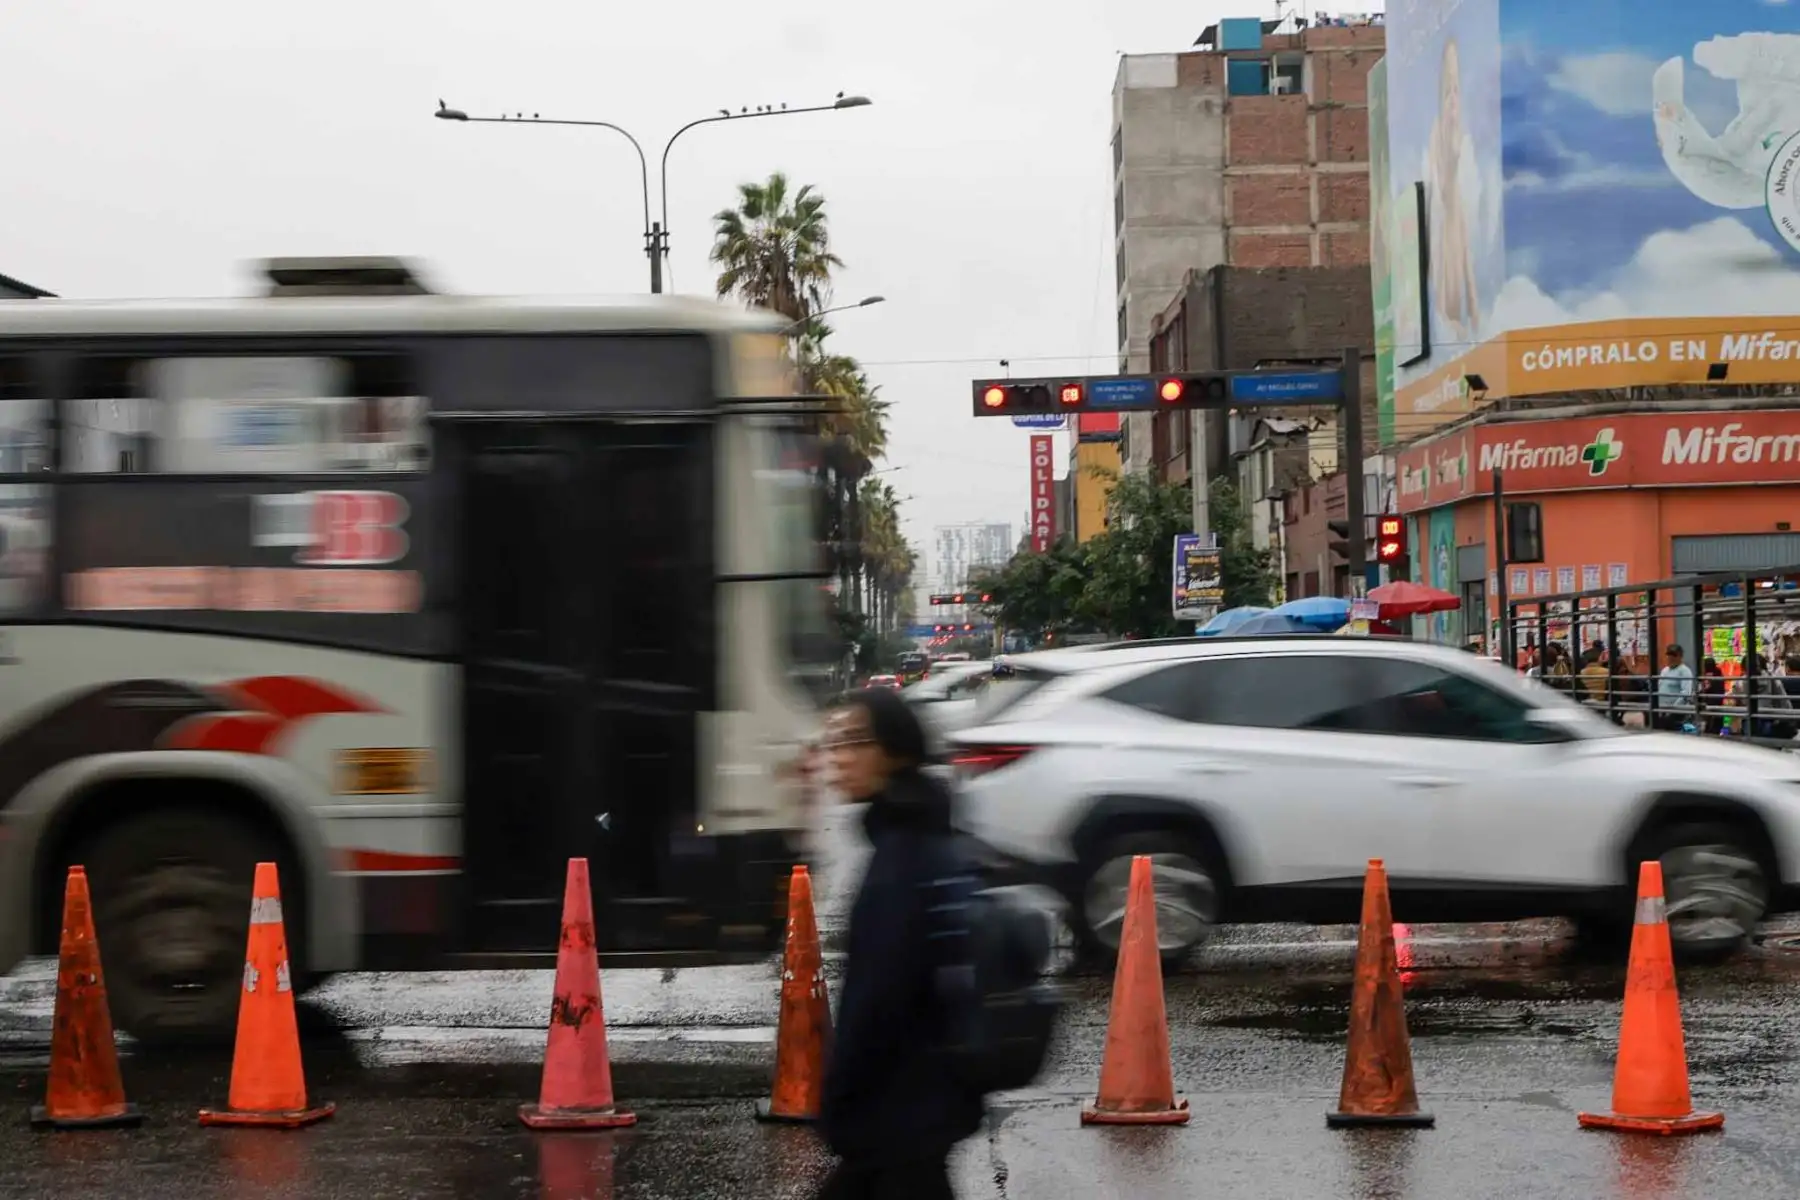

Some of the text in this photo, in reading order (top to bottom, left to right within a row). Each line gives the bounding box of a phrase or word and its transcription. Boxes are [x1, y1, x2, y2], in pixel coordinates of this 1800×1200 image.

[1522, 332, 1800, 371] CÓMPRALO EN Mifar
[1479, 439, 1578, 471] Mifarma
